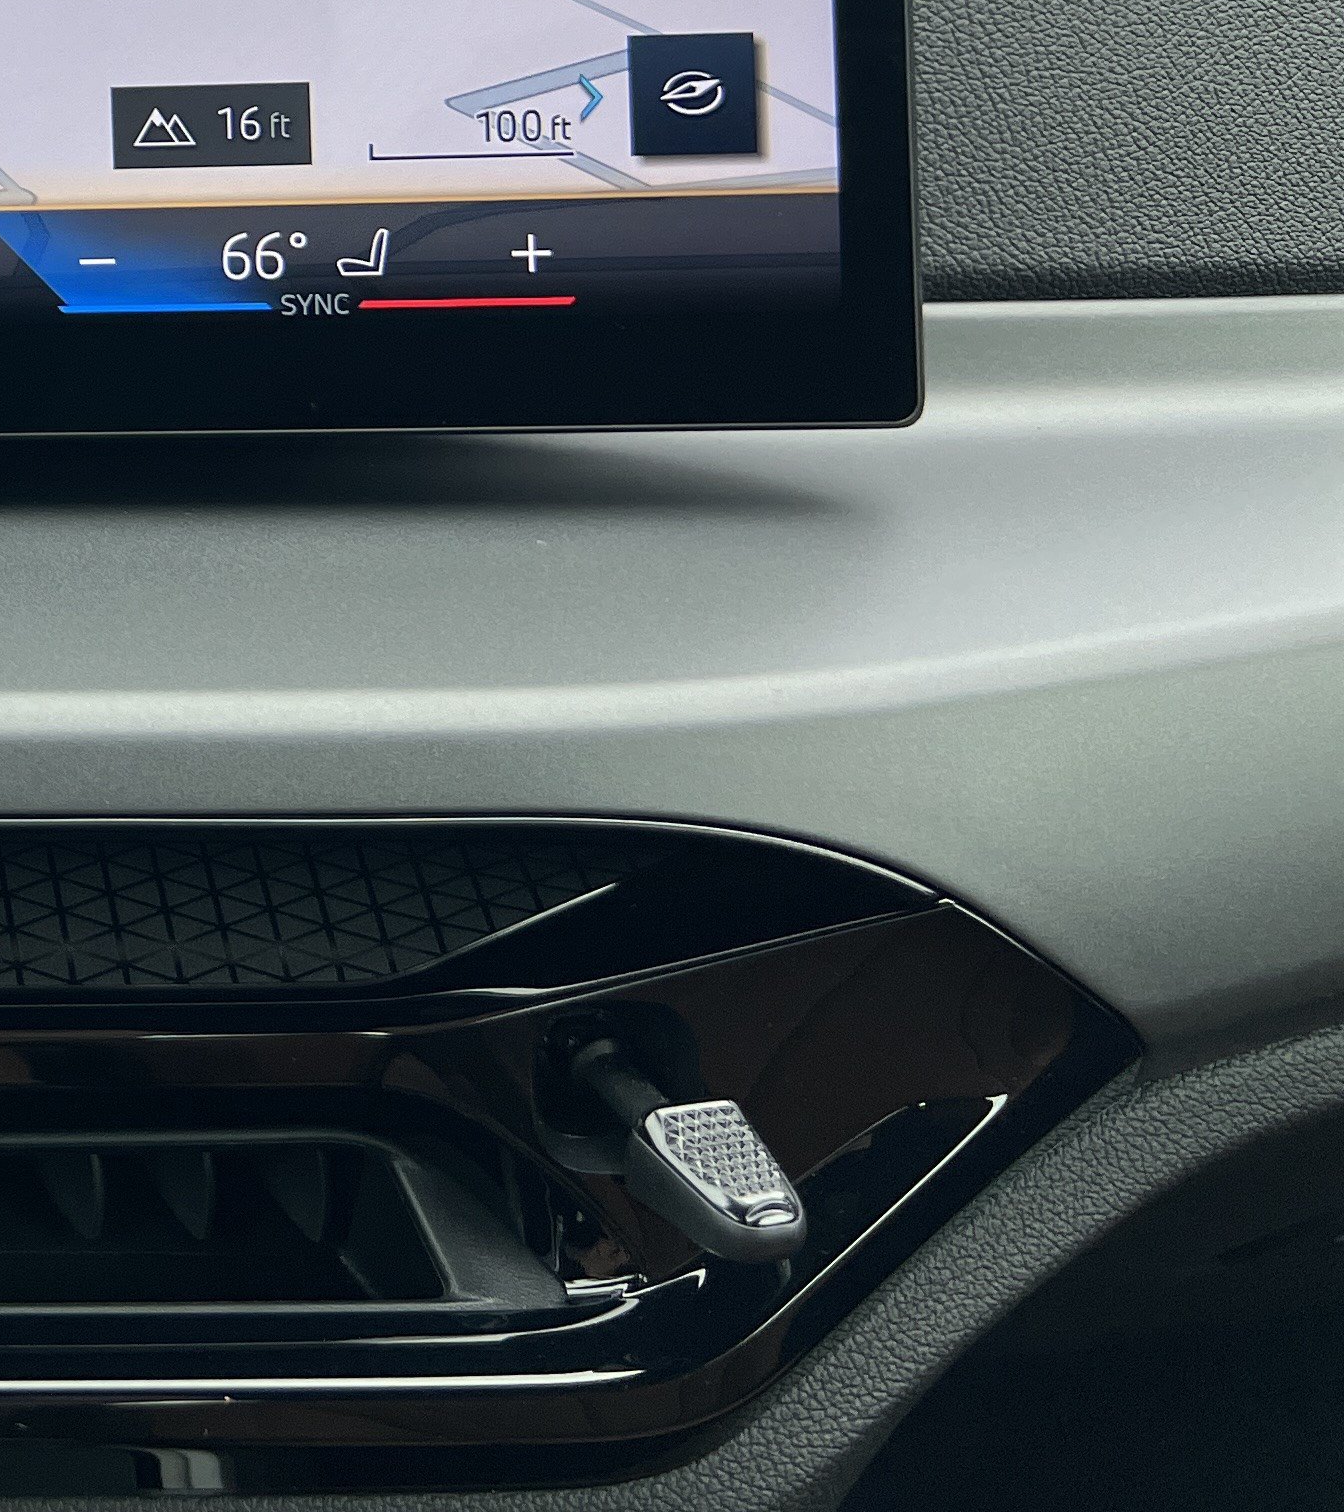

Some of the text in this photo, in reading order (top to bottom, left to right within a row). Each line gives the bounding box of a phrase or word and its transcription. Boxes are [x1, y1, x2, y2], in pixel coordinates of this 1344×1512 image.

[217, 106, 291, 141] 16 ft
[476, 110, 571, 143] 100 ft
[281, 293, 350, 317] SYNC
